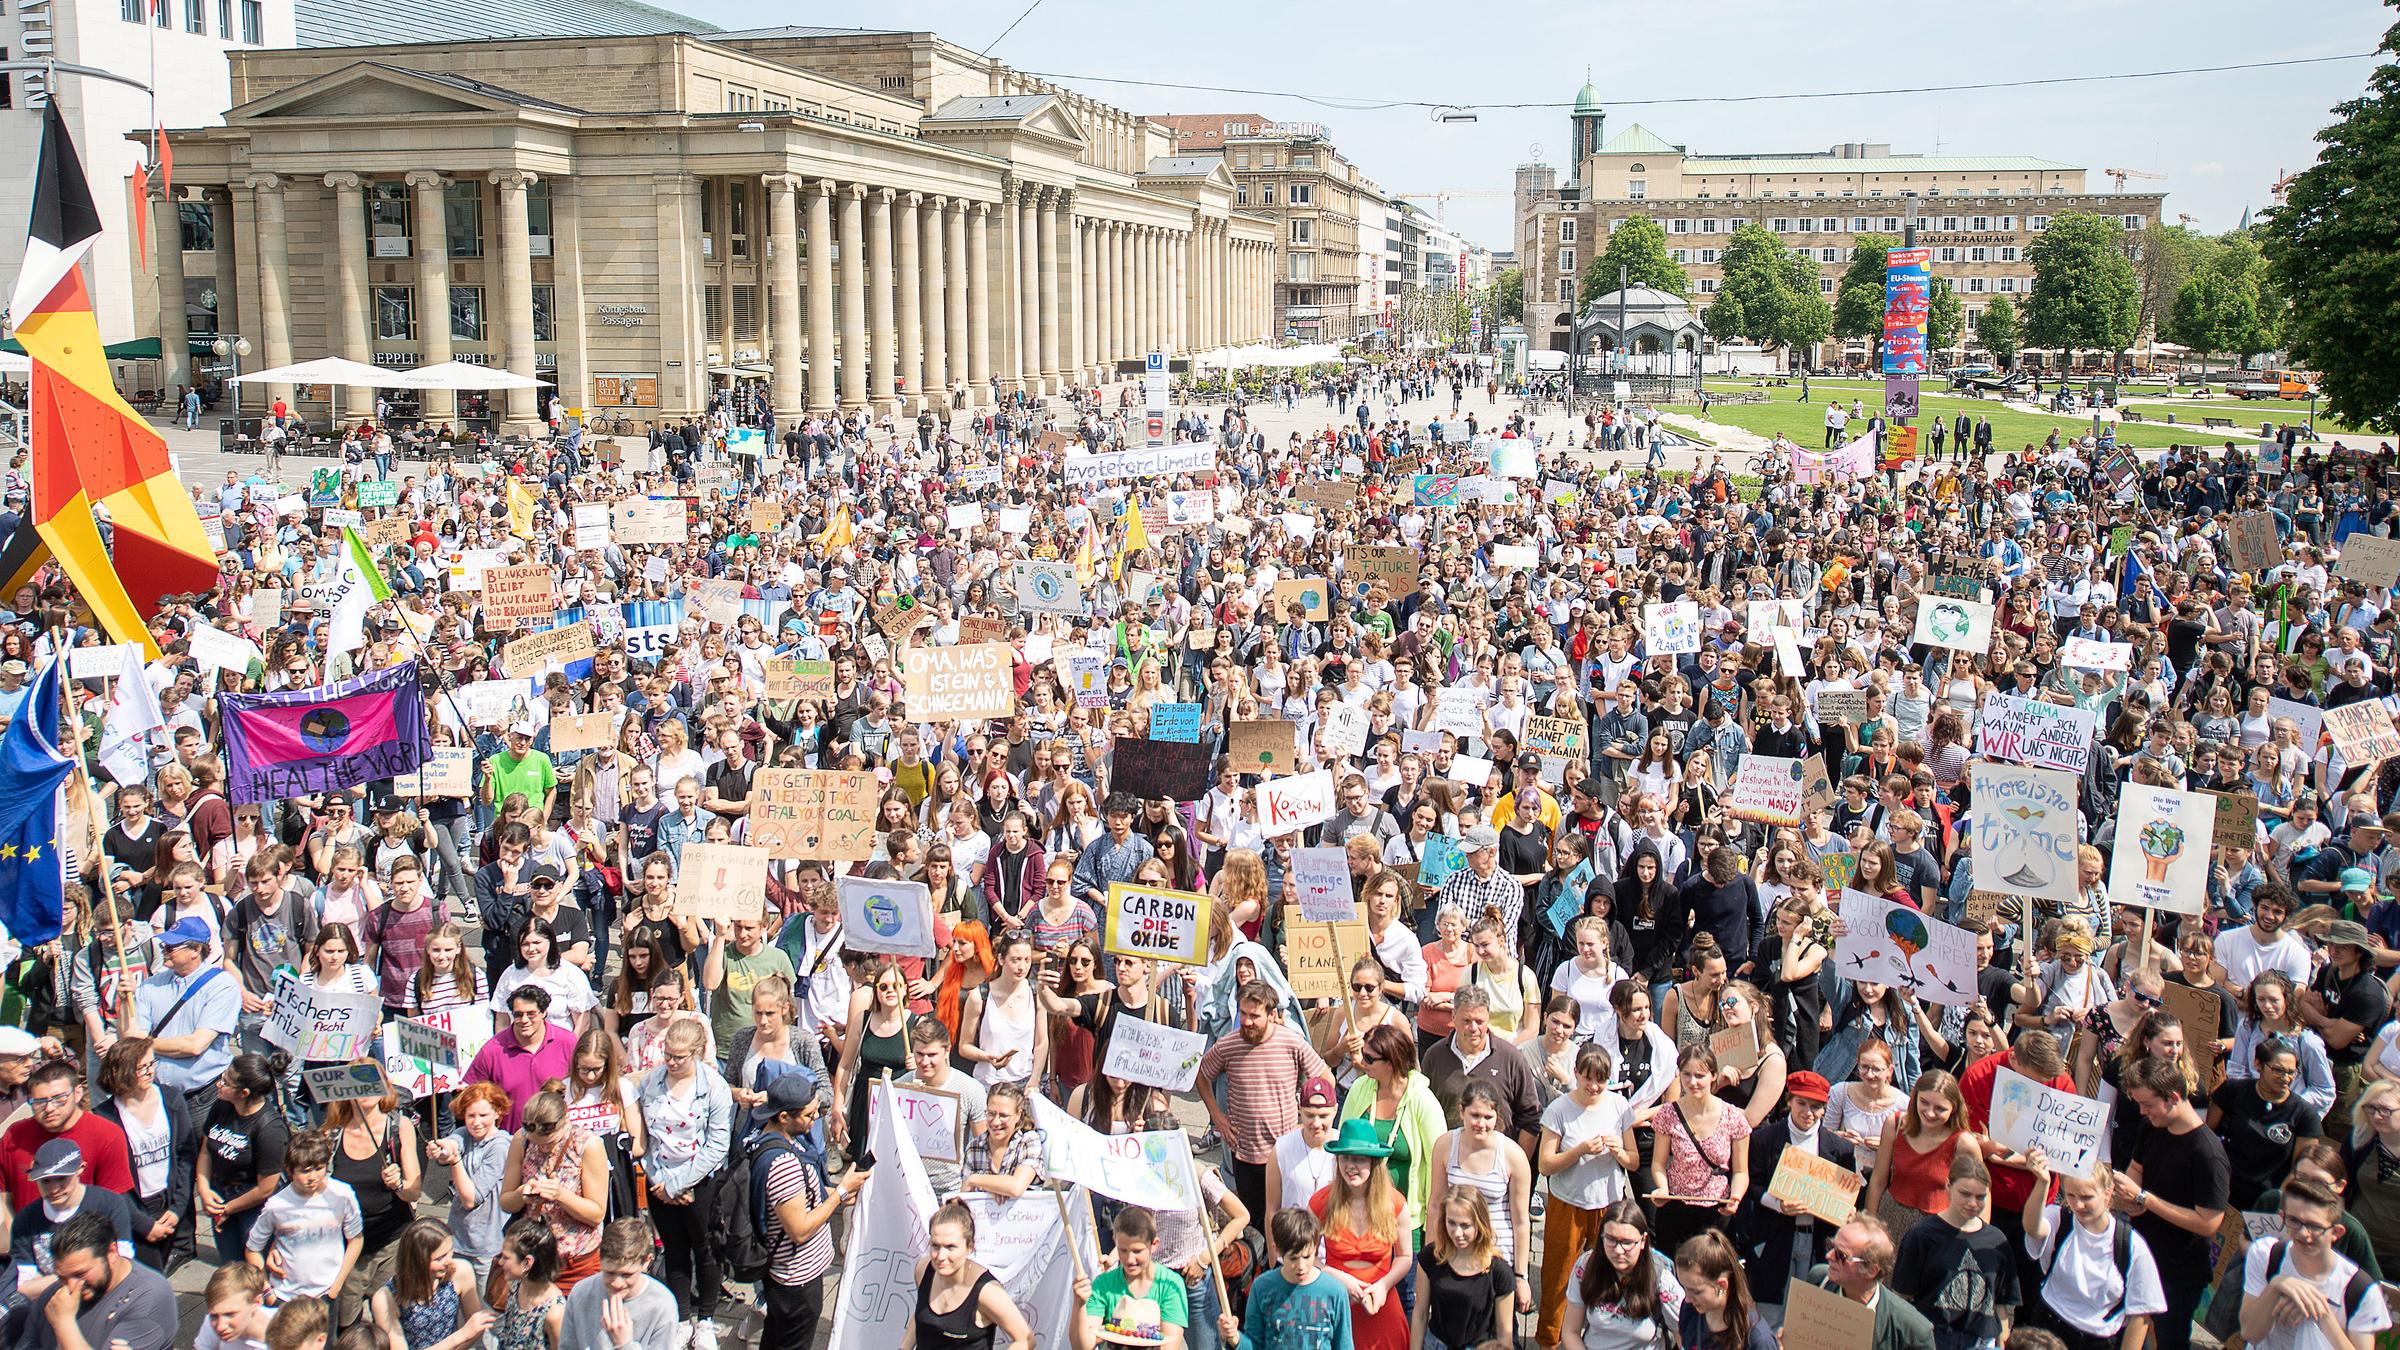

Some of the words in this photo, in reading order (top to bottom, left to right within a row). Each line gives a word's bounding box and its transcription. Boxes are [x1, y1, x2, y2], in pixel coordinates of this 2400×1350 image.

[1954, 234, 2015, 243] BRAUHAUS
[1890, 274, 1928, 283] EU-Steuern
[598, 303, 647, 318] Königsbau
[601, 316, 643, 335] Passagen
[598, 379, 617, 389] BUY
[598, 388, 618, 396] SELL
[707, 460, 731, 470] GETTING
[1066, 451, 1211, 482] #voteforclimate
[360, 482, 395, 491] PARENTS
[1186, 499, 1207, 509] ZEIT
[378, 529, 391, 537] Not
[2236, 518, 2266, 535] SAVE
[2237, 534, 2263, 553] OUR
[1347, 547, 1367, 560] IT'S
[1371, 547, 1386, 559] OUR
[1360, 559, 1411, 574] FUTURE
[1928, 555, 1951, 577] We
[486, 568, 550, 584] BLAUKRAUT
[1364, 570, 1380, 581] ASK
[488, 582, 525, 595] BLEIBT
[1388, 577, 1409, 593] US
[1935, 574, 1980, 595] EARTH
[489, 593, 548, 606] BLAUKRAUT
[485, 608, 503, 618] UND
[504, 604, 552, 617] BRAUNKOHLE
[1657, 604, 1679, 617] THERE
[486, 619, 512, 630] BLEIBT
[890, 617, 910, 634] ODER
[908, 605, 927, 622] KEINE
[962, 618, 980, 629] GANZ
[1753, 620, 1761, 631] IS
[1650, 625, 1658, 637] IS
[1688, 623, 1698, 634] NO
[1655, 638, 1685, 653] PLANET
[1687, 635, 1695, 648] B
[511, 653, 534, 673] GANZ
[567, 636, 590, 654] EIS!
[909, 650, 956, 675] OMA,
[960, 648, 998, 671] WAS
[770, 661, 781, 672] BE
[781, 661, 793, 672] THE
[931, 673, 948, 693] IST
[948, 672, 981, 692] EIN
[909, 690, 1008, 715] SCHNEEMANN
[1079, 696, 1109, 708] SCHEISSE
[1155, 703, 1168, 712] Ihr
[1171, 704, 1187, 713] habt
[1988, 692, 2009, 709] DAS
[2024, 702, 2059, 719] KLIMA
[1155, 712, 1180, 727] Erde
[1180, 718, 1195, 726] von
[2335, 704, 2373, 726] PLANET
[1528, 717, 1557, 733] MAKE
[1562, 721, 1584, 736] THE
[1981, 717, 2027, 736] WARUM
[2057, 718, 2079, 736] SICH,
[1527, 728, 1564, 744] PLANET
[1550, 746, 1582, 760] AGAIN
[1982, 727, 2025, 761] WIR
[2021, 740, 2045, 758] UNS
[2049, 745, 2088, 765] NICHT?
[1743, 757, 1763, 773] Once
[252, 760, 318, 802] HEAL
[317, 752, 361, 790] THE
[783, 773, 833, 789] GETTING
[840, 775, 865, 792] HOT
[760, 789, 773, 802] IN
[776, 790, 811, 806] HERE,
[811, 790, 826, 803] SO
[829, 790, 859, 805] TAKE
[1975, 776, 2028, 801] there
[2028, 780, 2049, 800] is
[2046, 788, 2070, 811] no
[2153, 795, 2165, 804] Die
[2165, 797, 2181, 807] Welt
[759, 805, 777, 820] OFF
[777, 807, 798, 821] ALL
[800, 807, 827, 822] YOUR
[1768, 798, 1797, 816] MONEY
[1976, 812, 2076, 862] time
[2241, 832, 2253, 849] B
[1296, 871, 1343, 891] change
[1311, 885, 1329, 895] not
[1967, 893, 1998, 902] dachten
[1122, 895, 1196, 921] CARBON
[1302, 909, 1348, 922] change
[1841, 890, 1889, 916] HOTTER
[1929, 920, 1968, 948] THAN
[1131, 930, 1180, 950] OXIDE
[1297, 934, 1326, 951] NO
[278, 972, 353, 1021] Fischers
[271, 998, 302, 1039] Fritz
[312, 1021, 345, 1032] fischt
[293, 1030, 366, 1058] PLASTIK
[1117, 1023, 1165, 1050] THERE
[1139, 1048, 1161, 1063] NO
[1113, 1055, 1170, 1079] PLANET
[311, 1070, 345, 1083] OUR
[316, 1081, 384, 1099] FUTURE
[570, 1103, 613, 1120] DON'T
[2036, 1092, 2066, 1117] Die
[2065, 1102, 2100, 1128] Zeit
[2032, 1113, 2068, 1142] läuft
[2073, 1131, 2096, 1148] uns
[1106, 1136, 1142, 1160] NO
[1782, 1151, 1804, 1170] WIE
[1837, 1173, 1860, 1194] MIT
